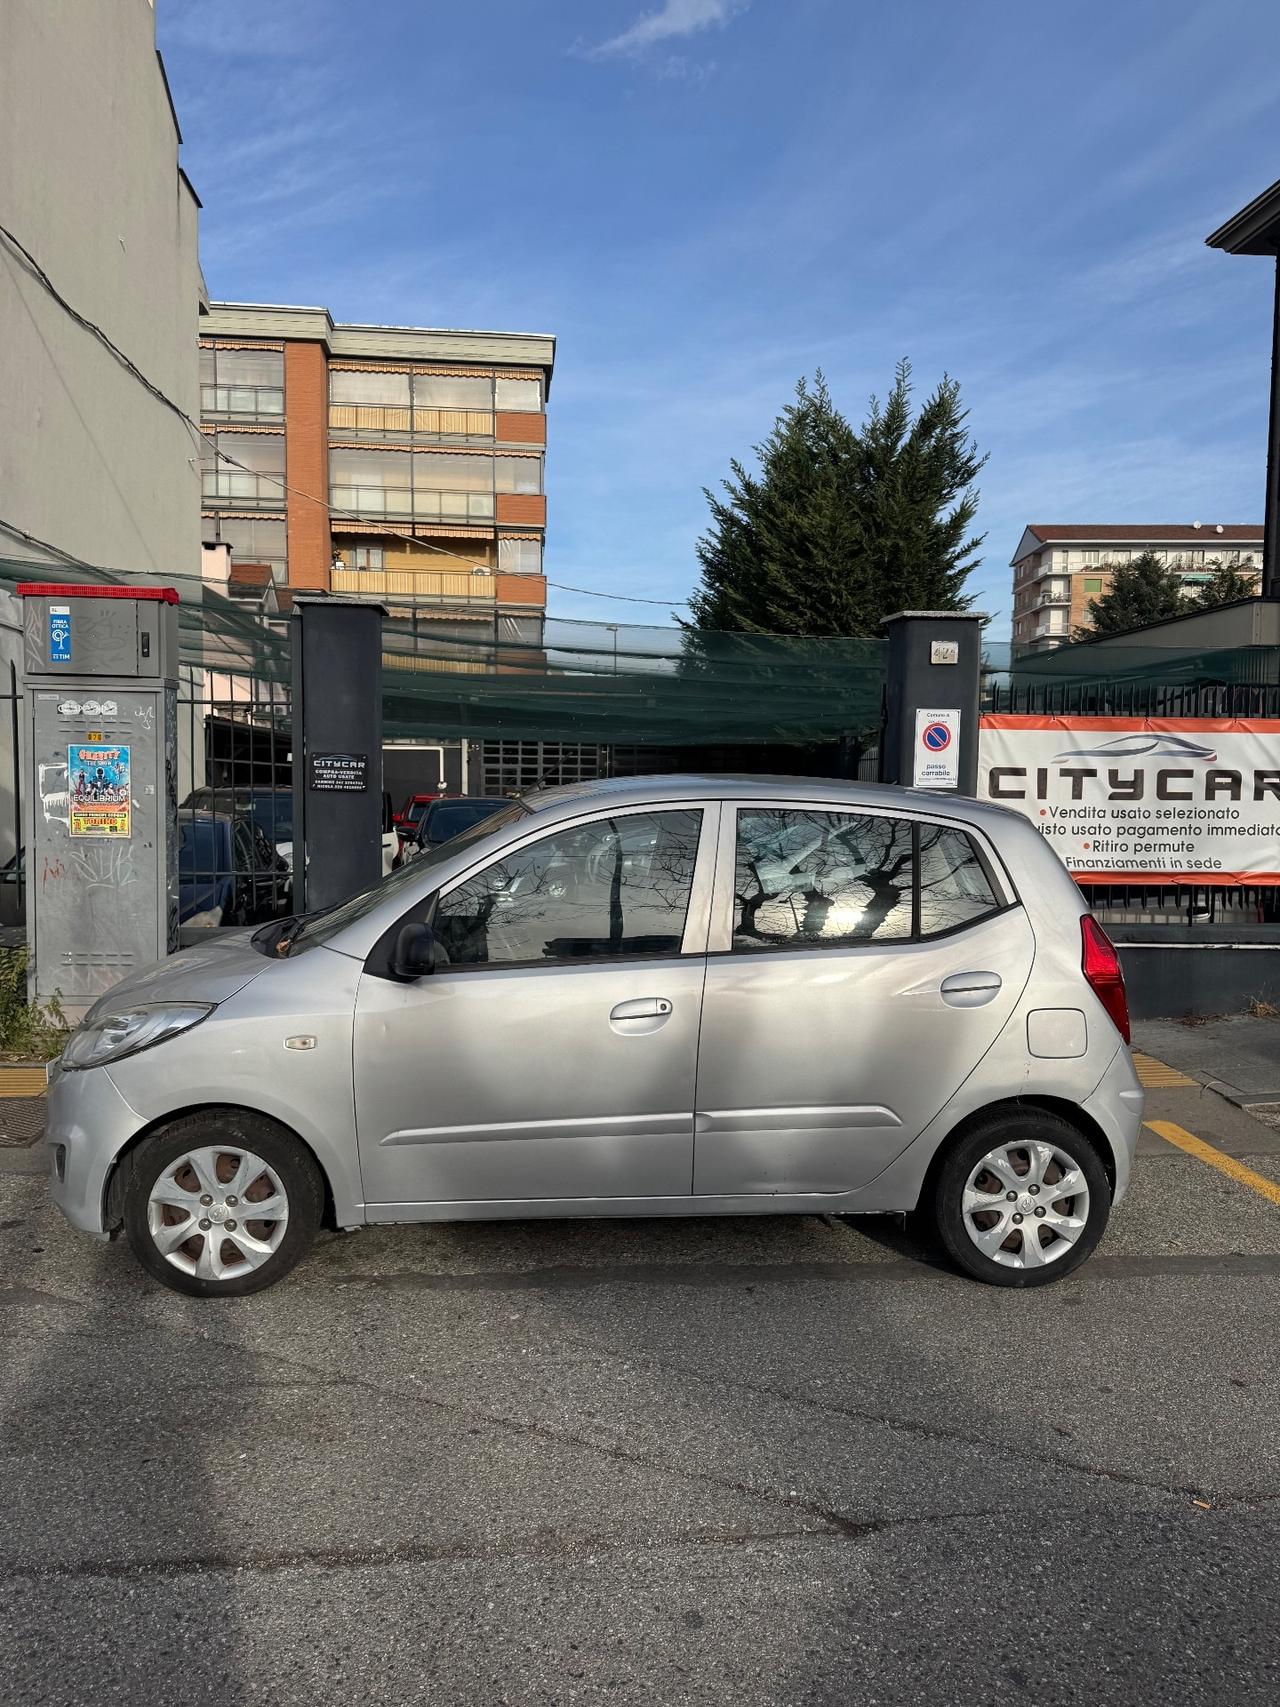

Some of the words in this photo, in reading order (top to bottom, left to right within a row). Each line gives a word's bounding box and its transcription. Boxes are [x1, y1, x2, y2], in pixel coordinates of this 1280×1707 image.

[313, 760, 366, 769] CITYCAR
[988, 766, 1280, 801] CITYCAR
[1049, 806, 1106, 819] Vendita
[1111, 807, 1151, 819] usato
[1155, 807, 1240, 819] selezionato
[1071, 823, 1112, 836] usato
[1116, 824, 1202, 839] pagamento
[1207, 824, 1280, 836] immediato
[1093, 840, 1129, 853] Ritiro
[1133, 841, 1195, 855] permute
[1065, 857, 1165, 868] Finanziamenti
[1170, 857, 1183, 868] in
[1187, 857, 1222, 869] sede
